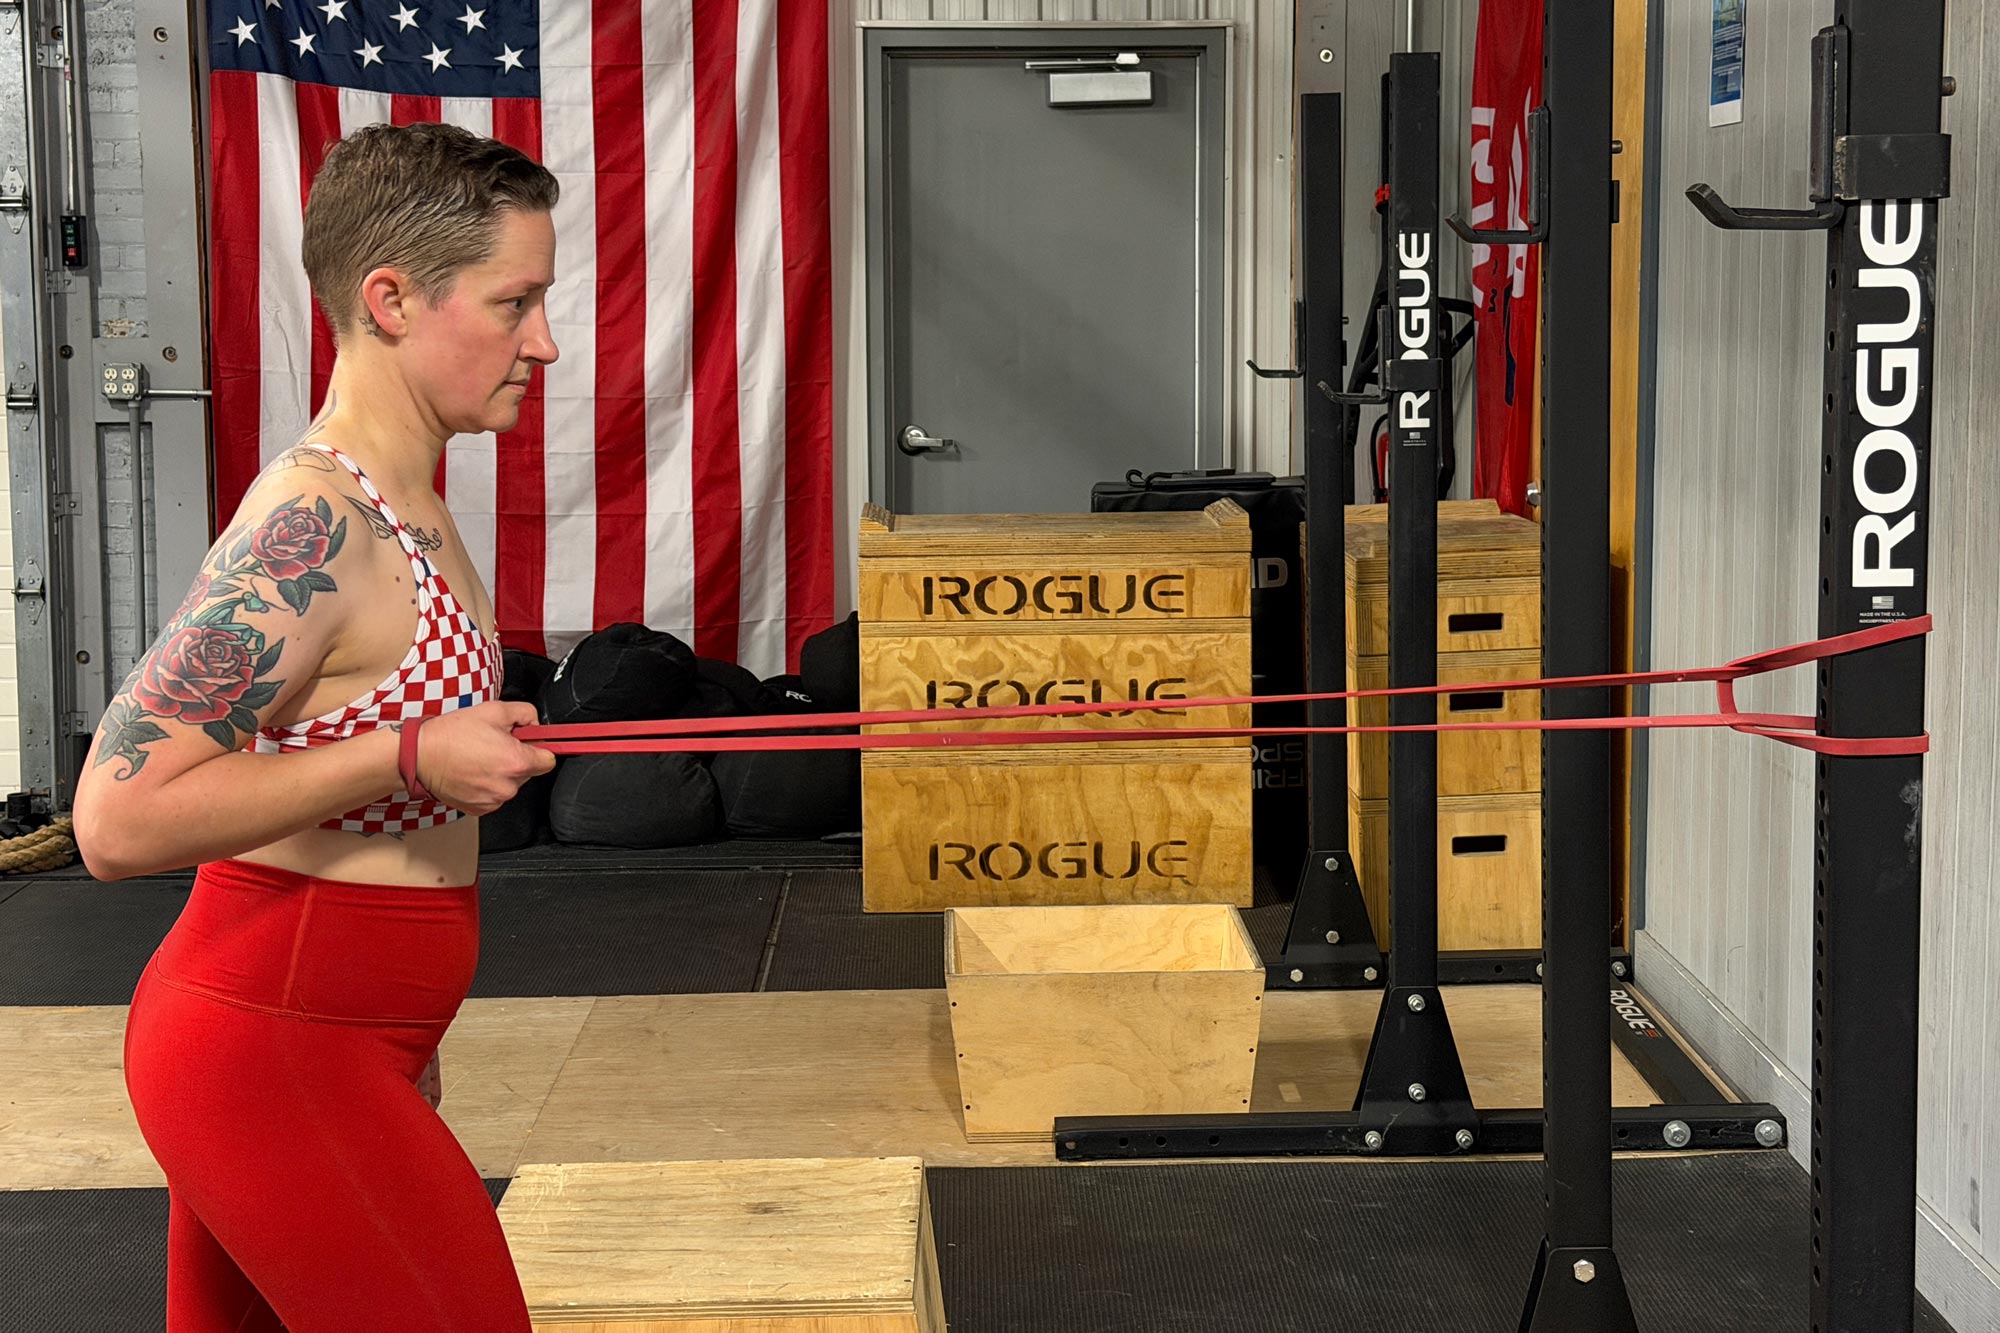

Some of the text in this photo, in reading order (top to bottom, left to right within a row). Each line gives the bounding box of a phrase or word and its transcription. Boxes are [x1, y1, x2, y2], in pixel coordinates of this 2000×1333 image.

[1399, 232, 1430, 428] RGUE
[1852, 199, 1923, 588] ROGUE
[922, 573, 1186, 615] ROGUE
[926, 678, 1187, 717] ROGUE
[928, 840, 1188, 881] ROGUE
[1610, 990, 1656, 1029] ROGUE
